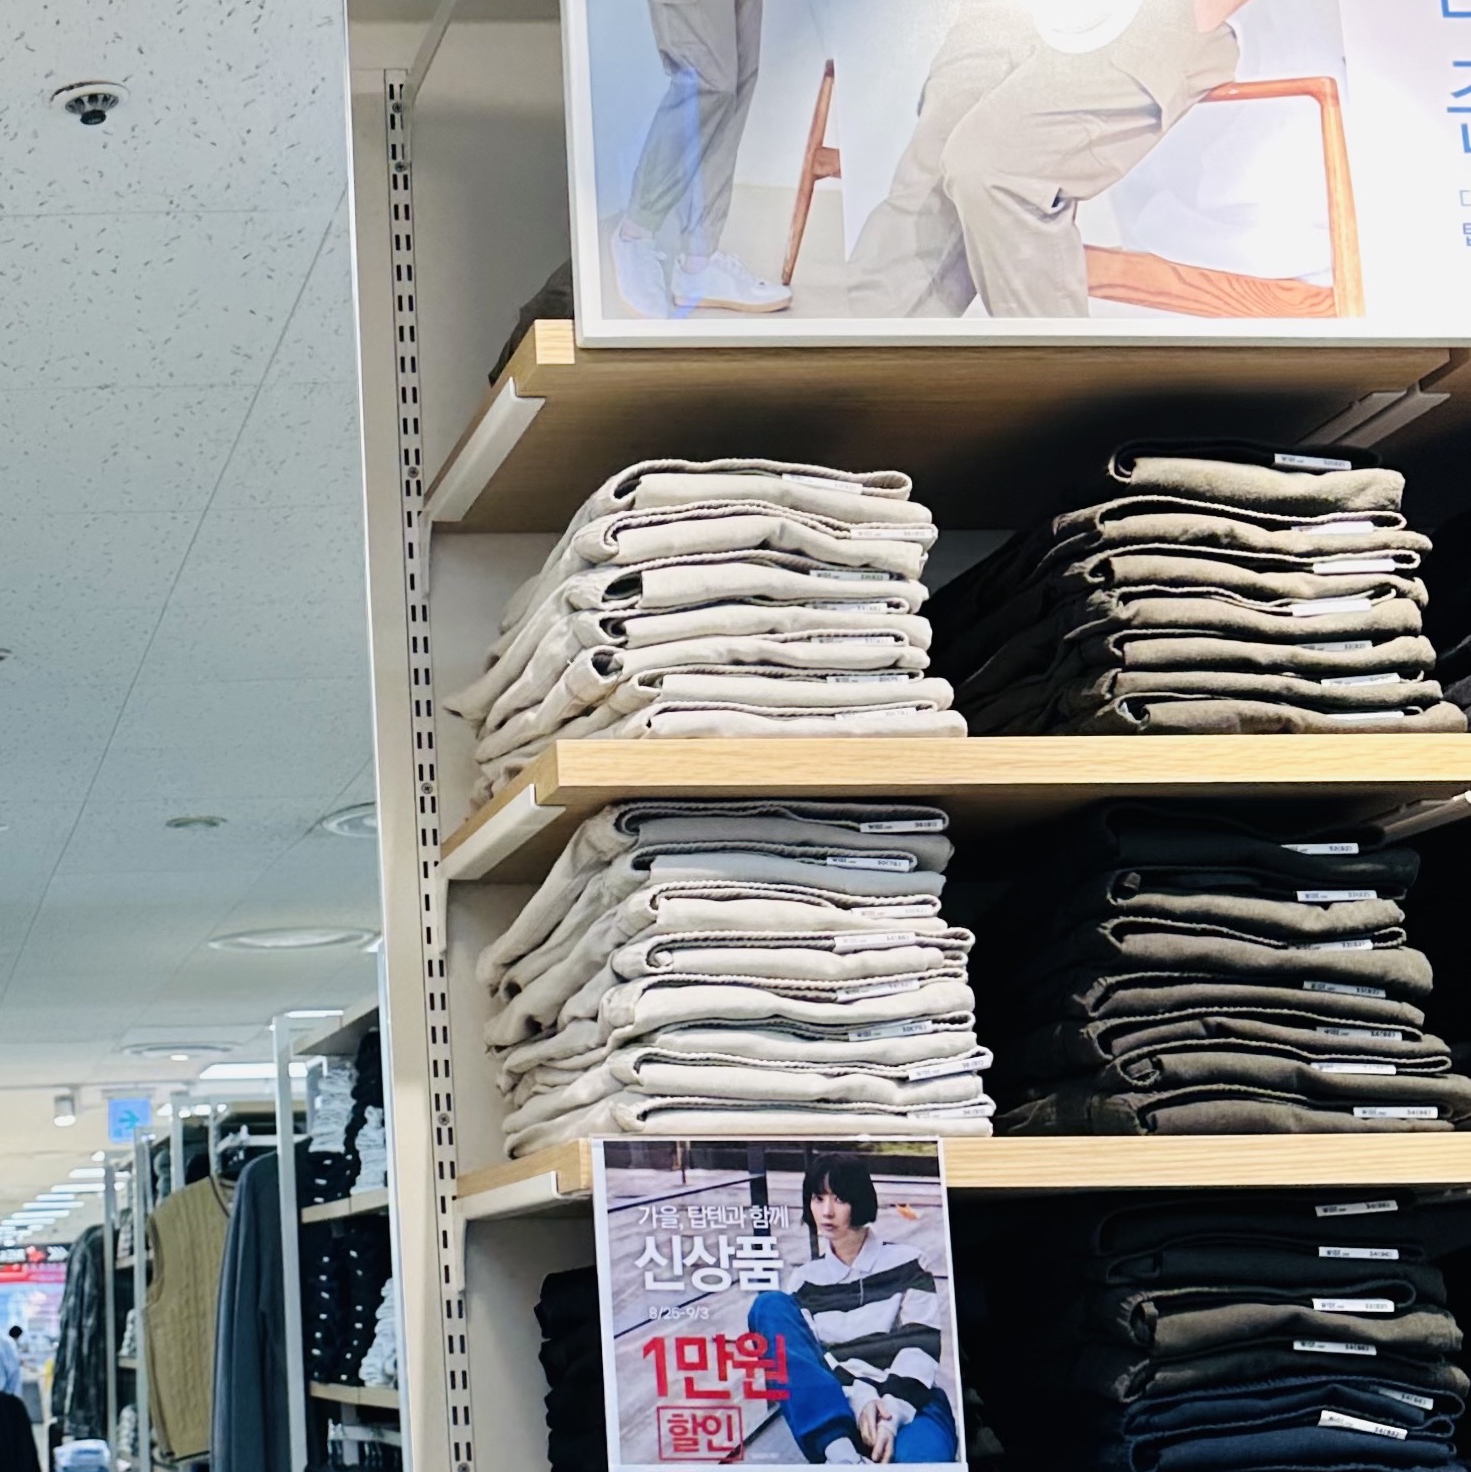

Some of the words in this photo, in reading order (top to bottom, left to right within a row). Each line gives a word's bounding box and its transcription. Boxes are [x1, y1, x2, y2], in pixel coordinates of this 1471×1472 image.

[638, 1204, 684, 1231] 가을,
[687, 1204, 746, 1230] 탑텐과
[749, 1205, 790, 1230] 함께
[634, 1234, 785, 1293] 신상품
[642, 1332, 790, 1400] 1만원
[666, 1412, 735, 1453] 할인
